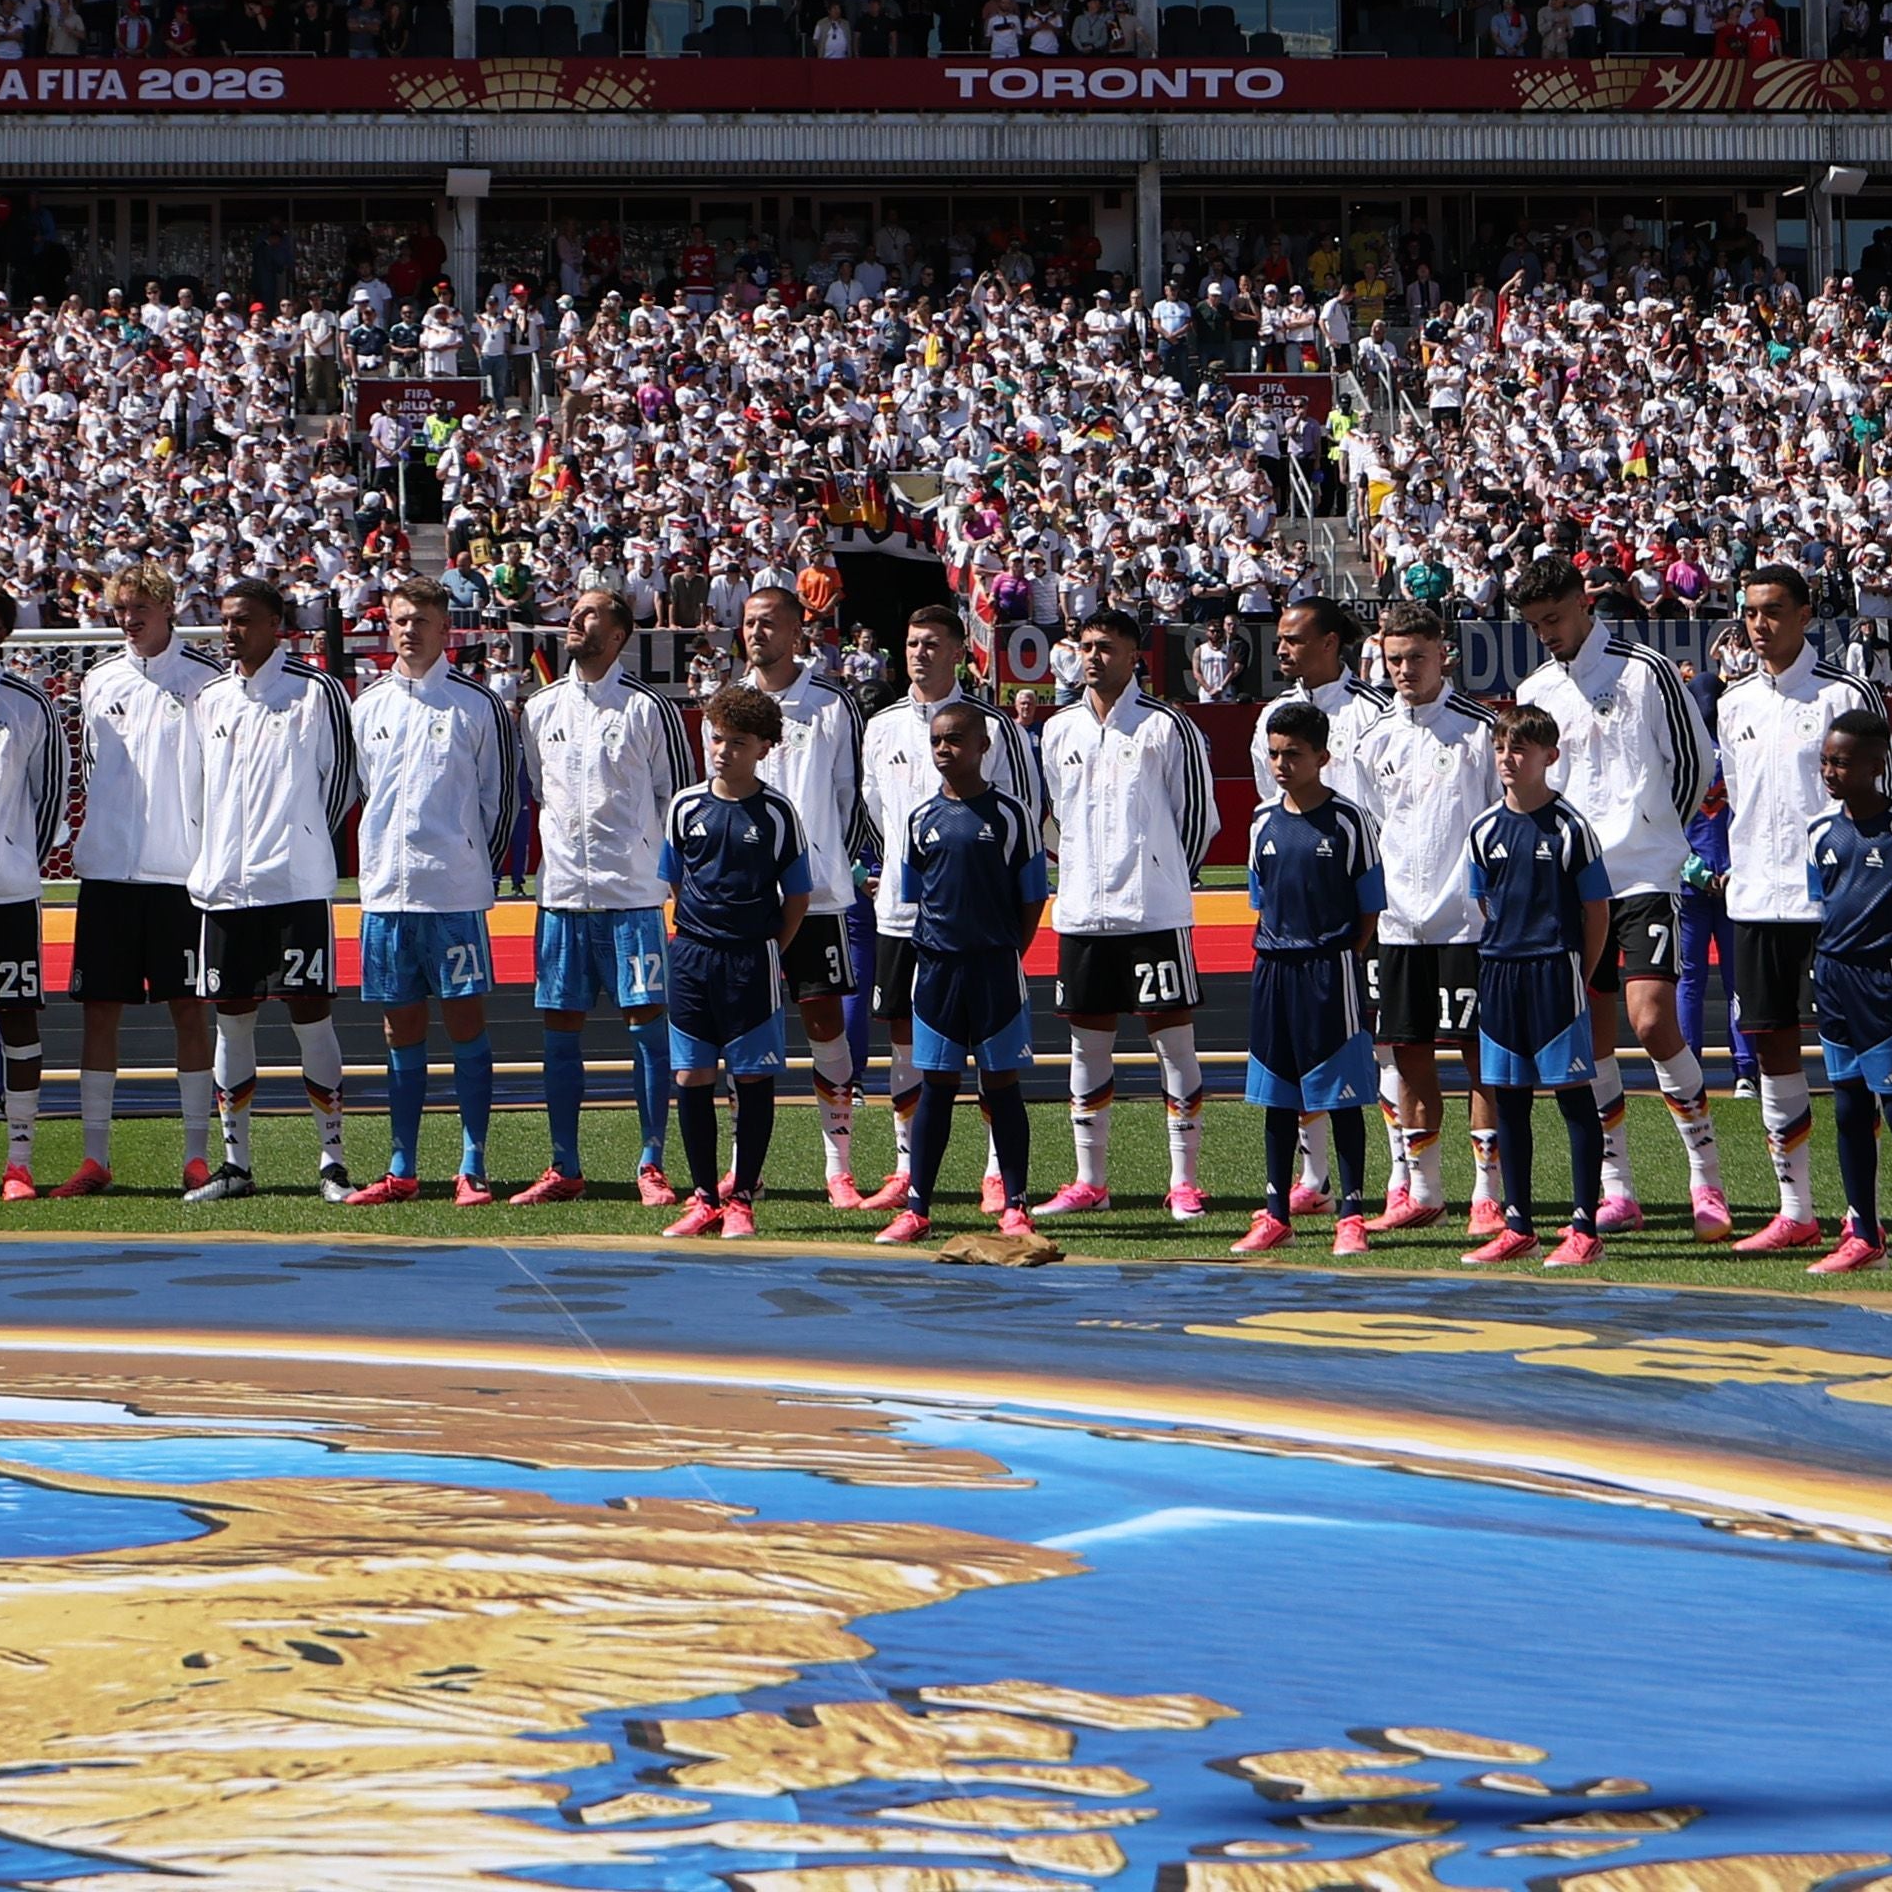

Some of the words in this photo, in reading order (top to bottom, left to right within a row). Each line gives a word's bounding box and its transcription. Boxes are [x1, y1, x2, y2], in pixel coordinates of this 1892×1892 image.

[37, 68, 128, 101] FIFA
[137, 67, 286, 100] 2026
[944, 67, 1285, 99] TORONTO
[404, 388, 433, 399] FIFA
[1258, 383, 1285, 395] FIFA
[446, 942, 485, 984] 21
[1648, 924, 1670, 965] 7
[183, 949, 198, 986] 1
[283, 948, 324, 986] 24
[628, 953, 664, 993] 12
[827, 945, 844, 984] 3
[1134, 961, 1179, 1002] 20
[1438, 987, 1479, 1029] 17
